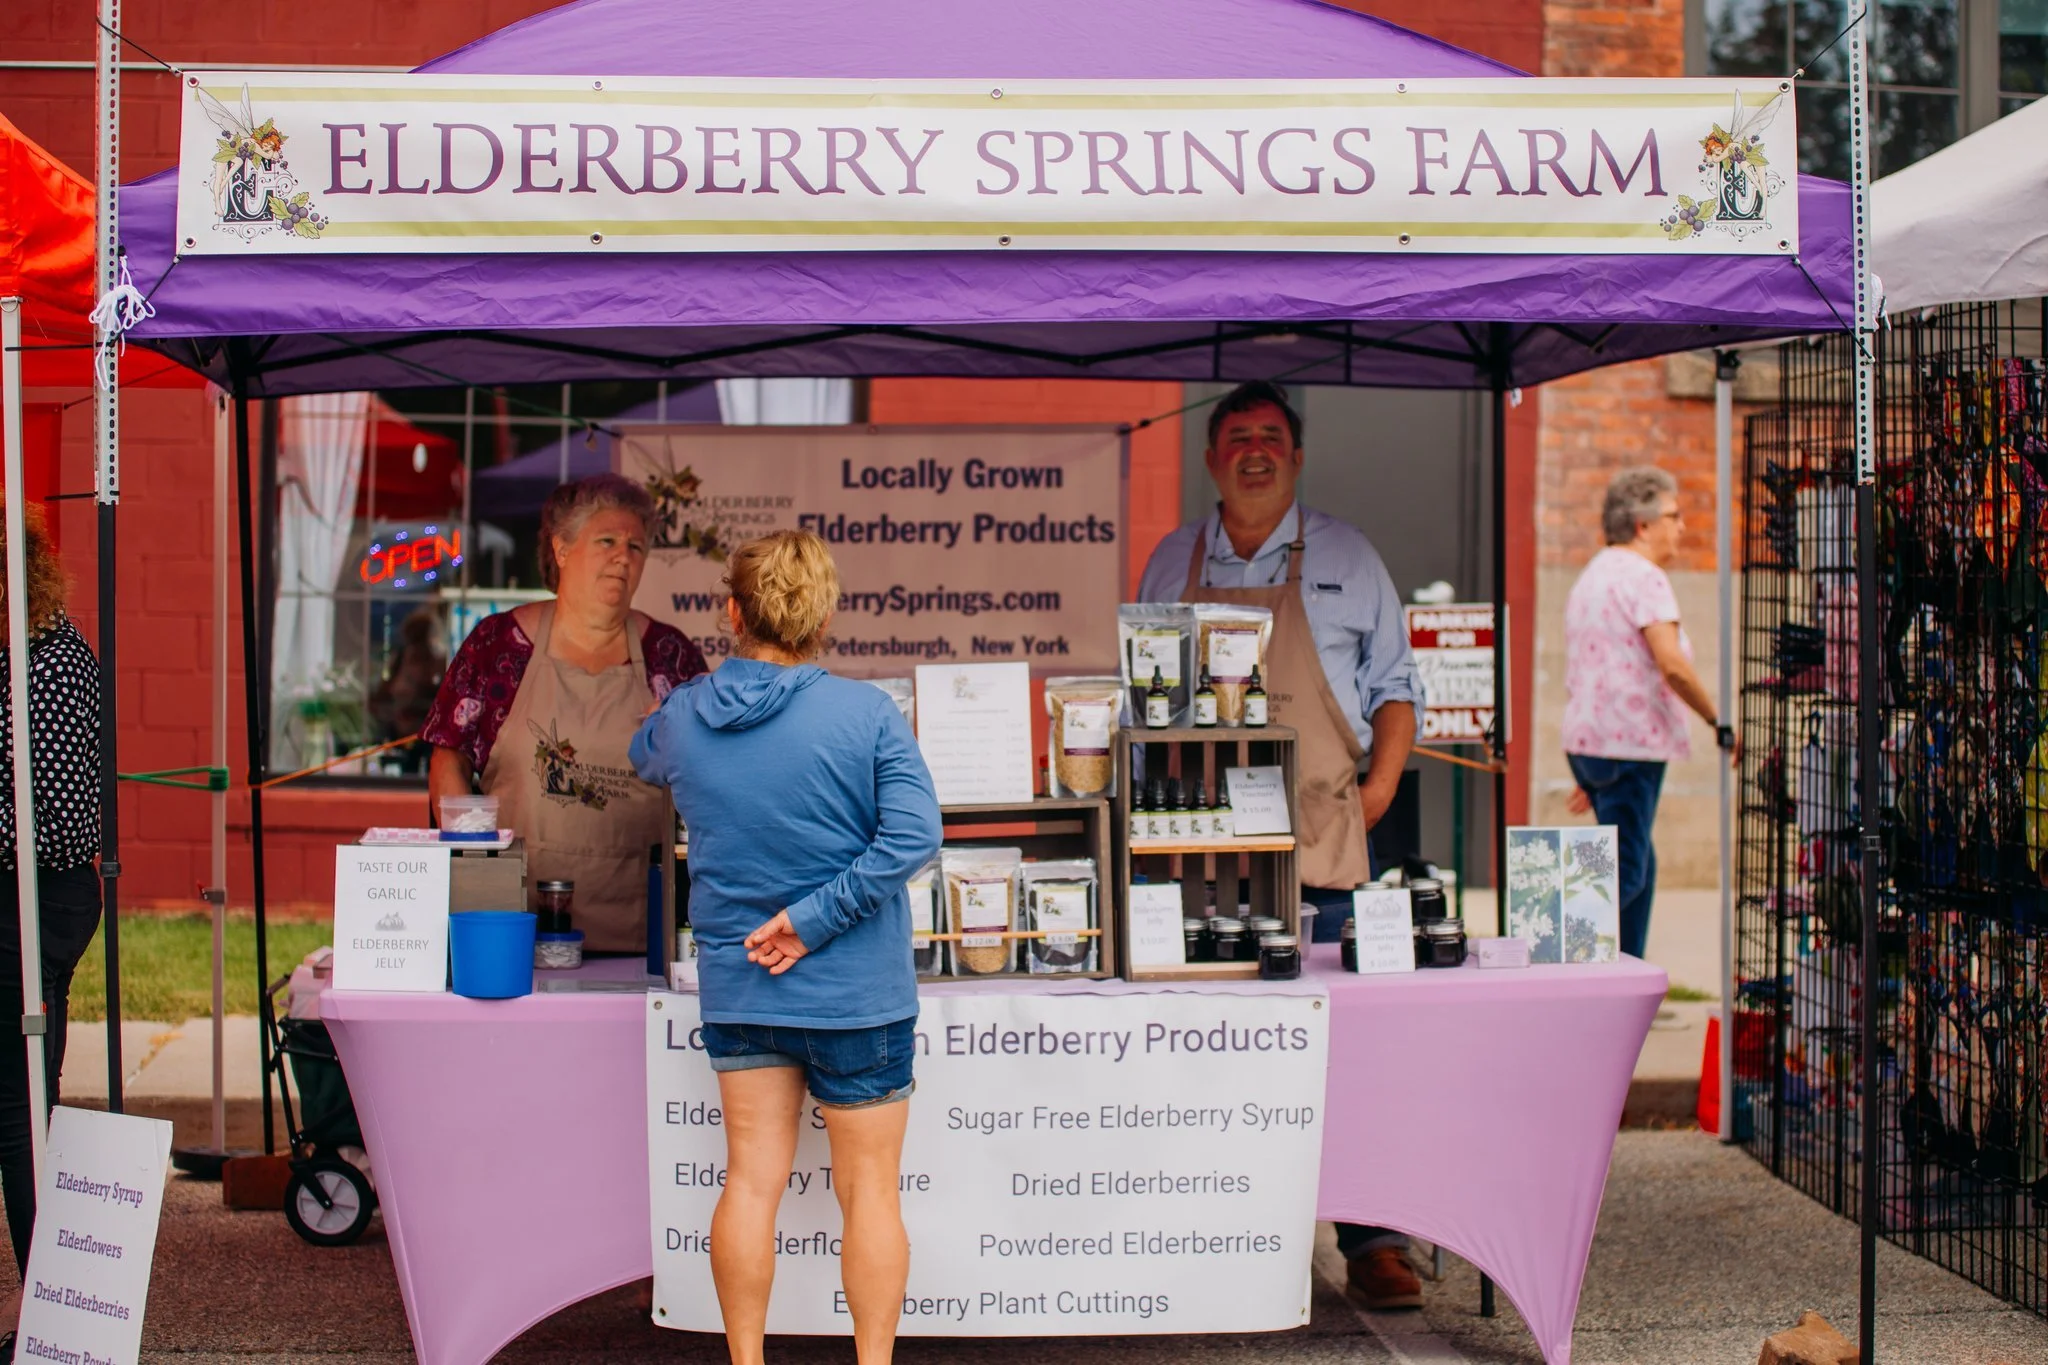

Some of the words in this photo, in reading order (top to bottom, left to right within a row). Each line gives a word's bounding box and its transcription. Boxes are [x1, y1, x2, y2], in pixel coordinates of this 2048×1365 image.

[322, 122, 944, 196] ELDERBERRY
[975, 127, 1376, 197] SPRINGS
[1405, 126, 1669, 197] FARM
[842, 459, 953, 494] Locally
[963, 459, 1064, 488] Grown
[797, 513, 963, 549] Elderberry
[973, 513, 1116, 543] Products
[360, 528, 461, 585] OPEN
[971, 636, 1018, 655] New
[1023, 636, 1070, 655] York
[1420, 709, 1495, 739] ONLY
[358, 861, 393, 874] TASTE
[397, 861, 428, 874] OUR
[367, 887, 417, 900] GARLIC
[353, 938, 430, 951] ELDERBERRY
[374, 957, 407, 969] JELLY
[944, 1023, 1131, 1063] Elderberry
[1144, 1021, 1310, 1054] Products
[946, 1106, 1023, 1136] Sugar
[1033, 1105, 1091, 1130] Free
[1100, 1104, 1234, 1135] Elderberry
[1242, 1102, 1314, 1131] Syrup
[56, 1171, 111, 1203] Elderberry
[112, 1181, 144, 1209] Syrup
[1011, 1170, 1081, 1197] Dried
[1091, 1169, 1251, 1196] Elderberries
[57, 1228, 123, 1259] Elderflowers
[665, 1227, 711, 1253] Drie
[980, 1231, 1113, 1258] Powdered
[1122, 1230, 1282, 1256] Elderberries
[34, 1280, 63, 1304] Dried
[64, 1288, 130, 1320] Elderberries
[979, 1289, 1049, 1315] Plant
[1056, 1289, 1170, 1317] Cuttings
[25, 1336, 81, 1365] Elderberry
[83, 1350, 117, 1365] Powd
